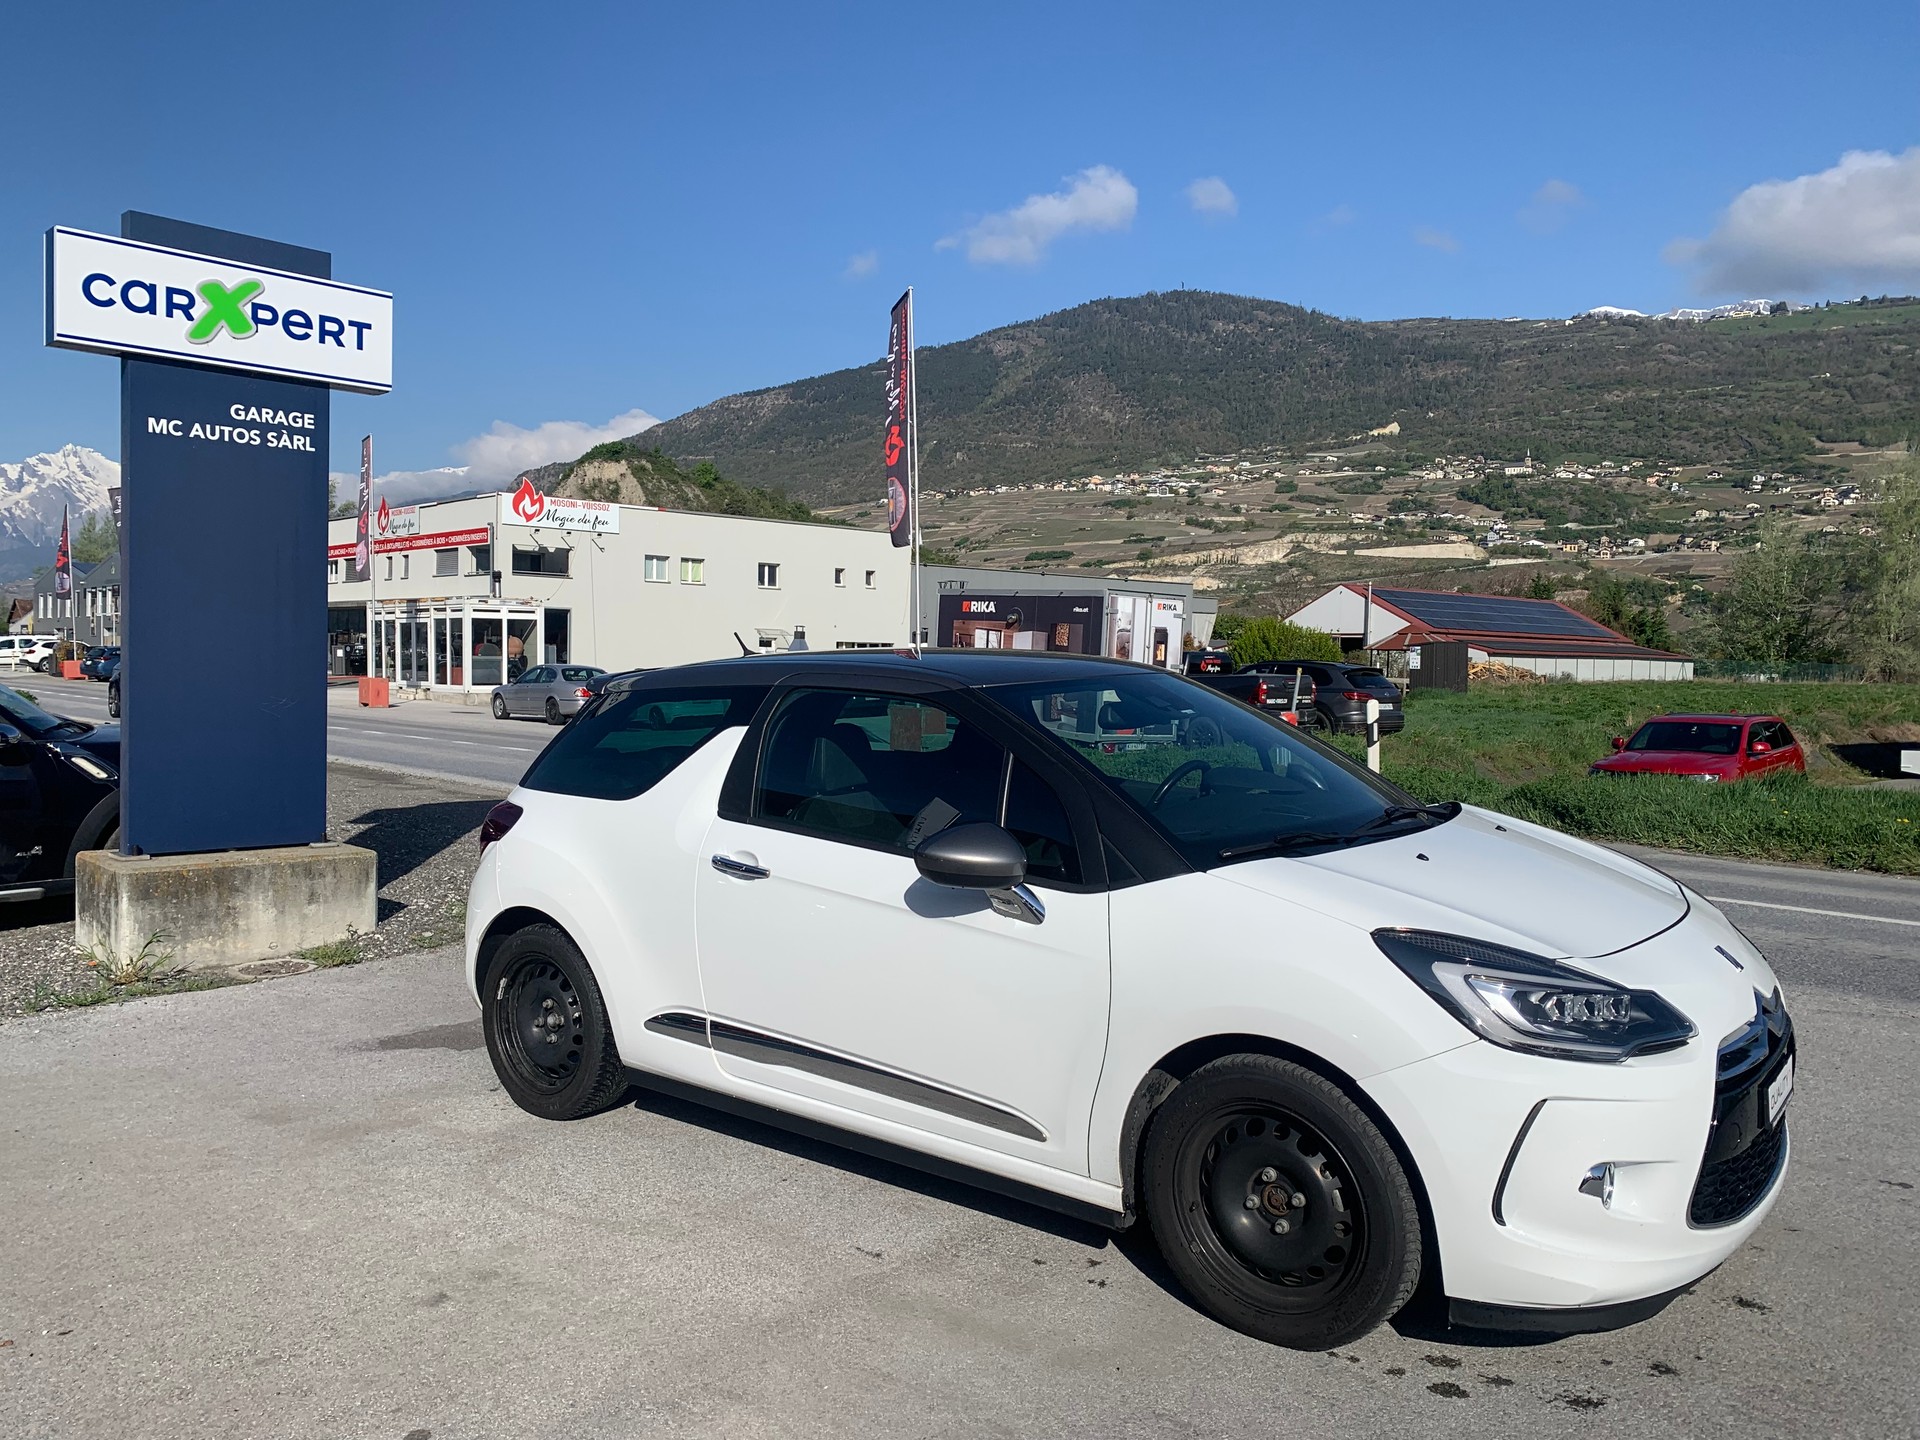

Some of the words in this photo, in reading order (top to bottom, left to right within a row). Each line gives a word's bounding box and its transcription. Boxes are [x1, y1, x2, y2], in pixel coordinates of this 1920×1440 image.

[230, 404, 315, 429] GARAGE
[147, 417, 183, 436] MC
[189, 423, 261, 445] AUTOS
[266, 430, 316, 452] SÀRL
[550, 499, 611, 512] MOSONI-VUISSOZ
[537, 508, 576, 527] Magie
[577, 513, 591, 524] du
[592, 515, 610, 530] feu
[970, 601, 996, 613] RIKA
[1162, 603, 1178, 611] RIKA
